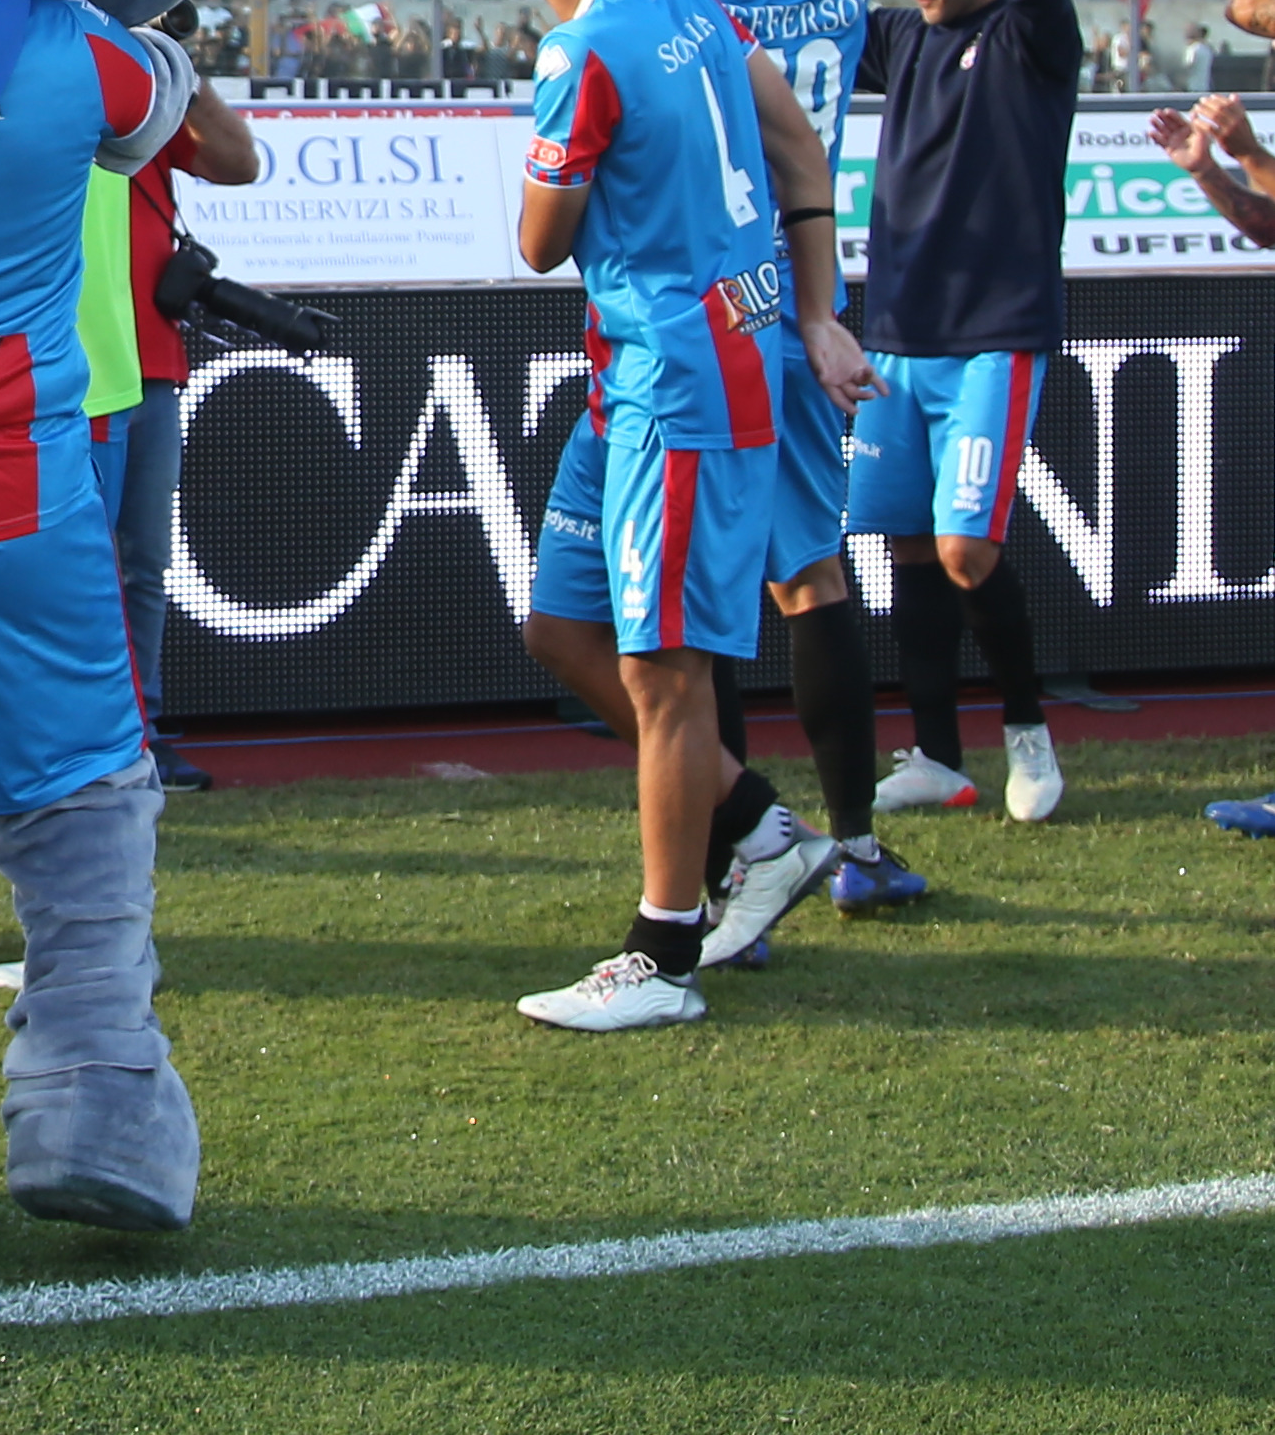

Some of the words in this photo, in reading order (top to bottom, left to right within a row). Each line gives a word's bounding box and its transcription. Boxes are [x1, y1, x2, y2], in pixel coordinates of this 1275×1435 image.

[195, 200, 390, 223] MULTISERVIZI
[330, 231, 412, 246] Installazione
[418, 229, 476, 247] Ponteggi
[957, 435, 994, 488] 10
[619, 519, 644, 583] 4
